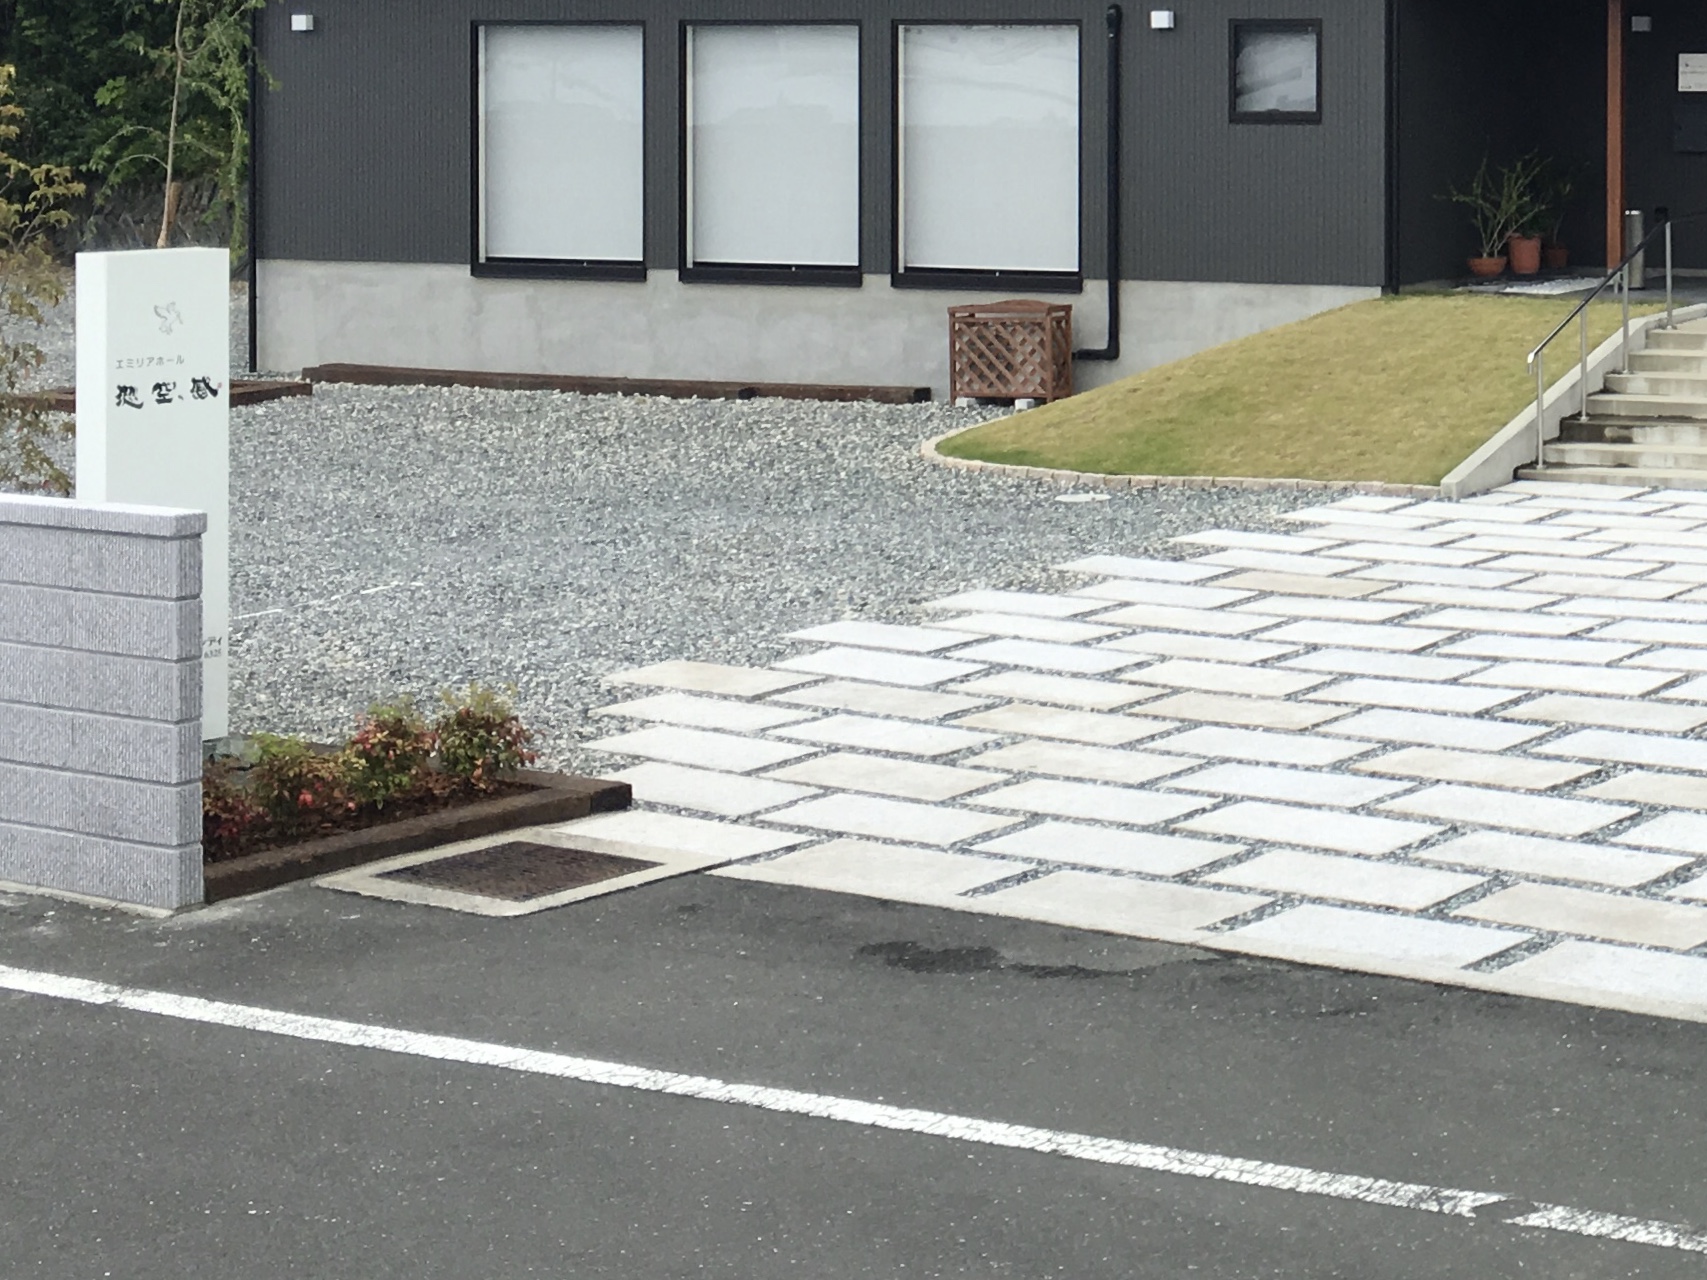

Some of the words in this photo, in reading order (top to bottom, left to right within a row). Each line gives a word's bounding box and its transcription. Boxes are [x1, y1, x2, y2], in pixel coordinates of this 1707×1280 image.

[115, 354, 185, 370] エミリアホール
